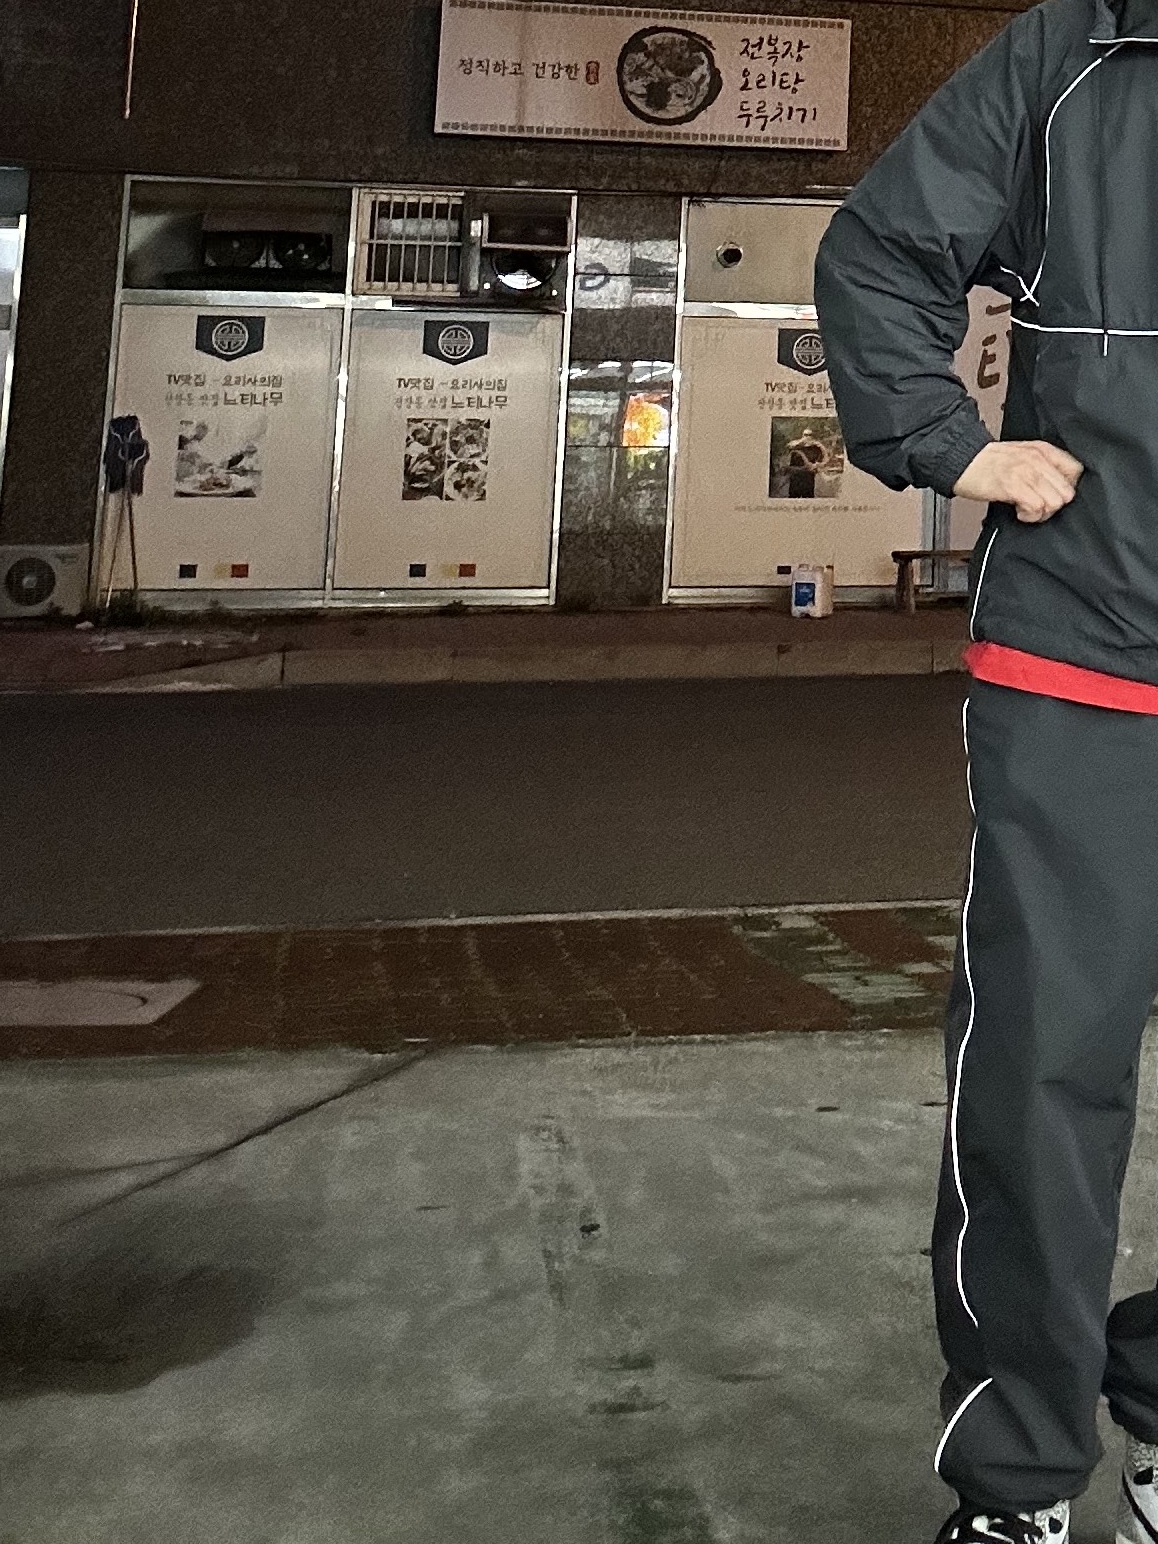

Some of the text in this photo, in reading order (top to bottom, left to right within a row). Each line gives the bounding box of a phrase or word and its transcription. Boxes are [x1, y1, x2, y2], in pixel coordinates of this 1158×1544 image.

[458, 57, 524, 76] 정직하고
[532, 61, 580, 81] 건강한
[740, 68, 805, 94] 오리탕
[737, 100, 817, 132] 두루치기
[223, 391, 283, 408] 느티나무
[451, 395, 508, 410] 느티나무
